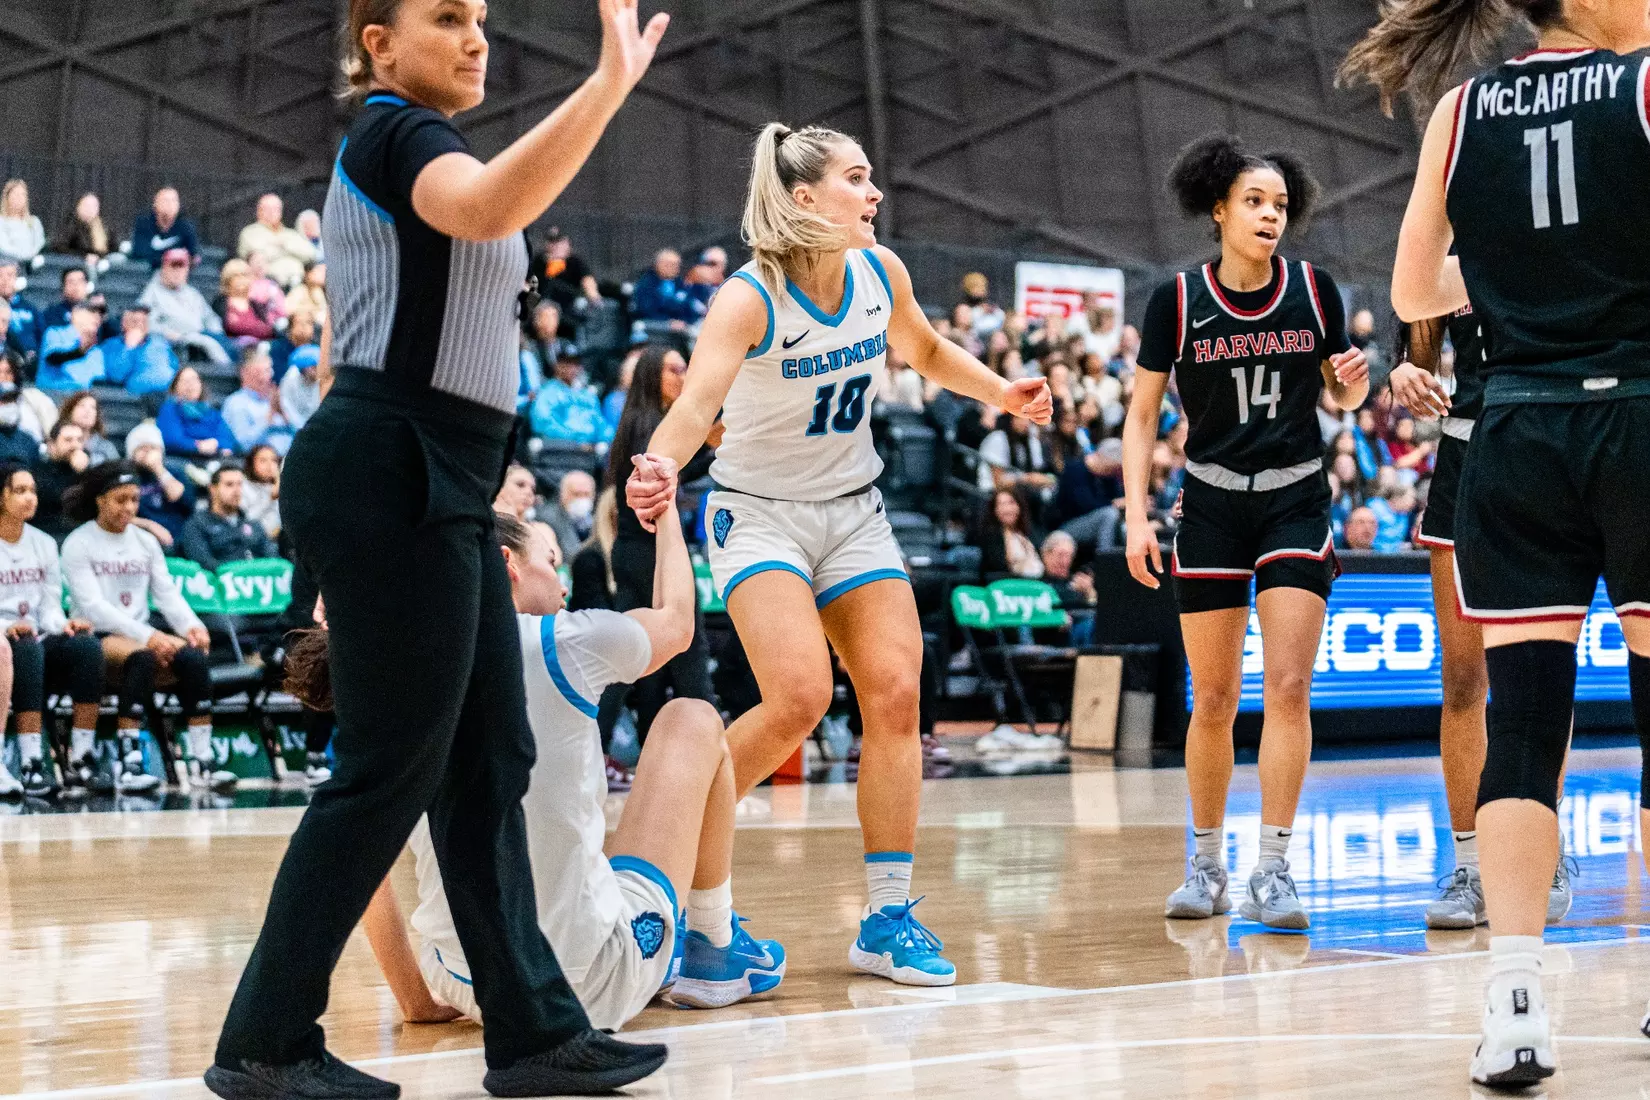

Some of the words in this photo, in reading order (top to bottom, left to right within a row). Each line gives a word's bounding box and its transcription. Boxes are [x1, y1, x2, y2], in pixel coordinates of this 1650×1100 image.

[1476, 64, 1625, 120] McCARTHY
[1524, 119, 1580, 229] 11
[1193, 329, 1315, 363] HARVARD
[805, 373, 872, 436] 10
[1231, 364, 1282, 424] 14
[221, 572, 274, 605] Ivy
[992, 589, 1033, 622] Ivy
